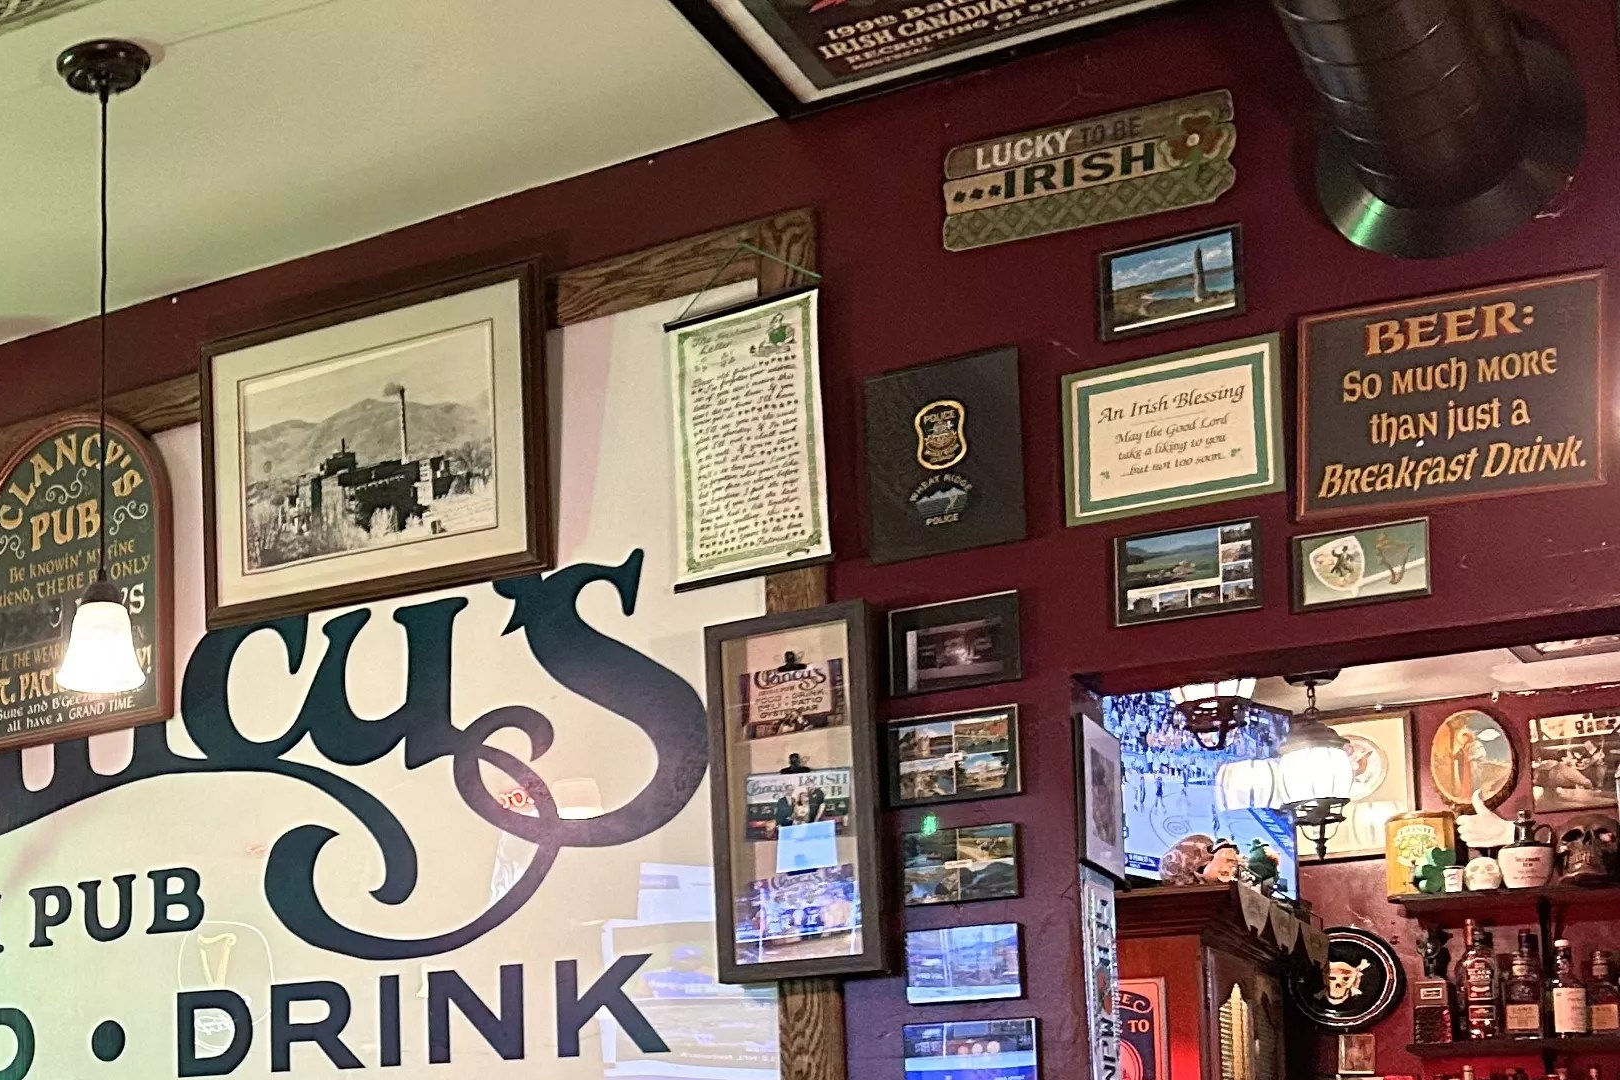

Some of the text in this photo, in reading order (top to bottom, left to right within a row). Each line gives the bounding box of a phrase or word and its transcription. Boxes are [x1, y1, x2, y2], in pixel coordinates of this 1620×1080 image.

[818, 30, 895, 60] IRISH
[975, 115, 1142, 171] LUCKY TO BE
[1004, 140, 1157, 200] IRISH
[1364, 301, 1534, 357] BEER:
[1097, 384, 1246, 424] An Irish Blessing
[1342, 370, 1382, 402] So
[1115, 411, 1230, 446] May the Good Lord
[1447, 397, 1501, 439] just
[1511, 398, 1531, 425] a
[1118, 433, 1228, 461] take a liking to you
[1152, 460, 1171, 471] not
[1175, 456, 1193, 468] too
[30, 498, 101, 552] PUB
[925, 512, 959, 526] POLICE
[36, 571, 85, 599] THERE
[110, 553, 151, 581] ONLY
[13, 651, 31, 670] THE
[6, 719, 21, 733] all
[26, 715, 53, 729] have
[68, 703, 106, 721] GRAND
[29, 865, 206, 950] PUB
[175, 952, 672, 1078] DRINK
[1128, 1019, 1150, 1033] TO
